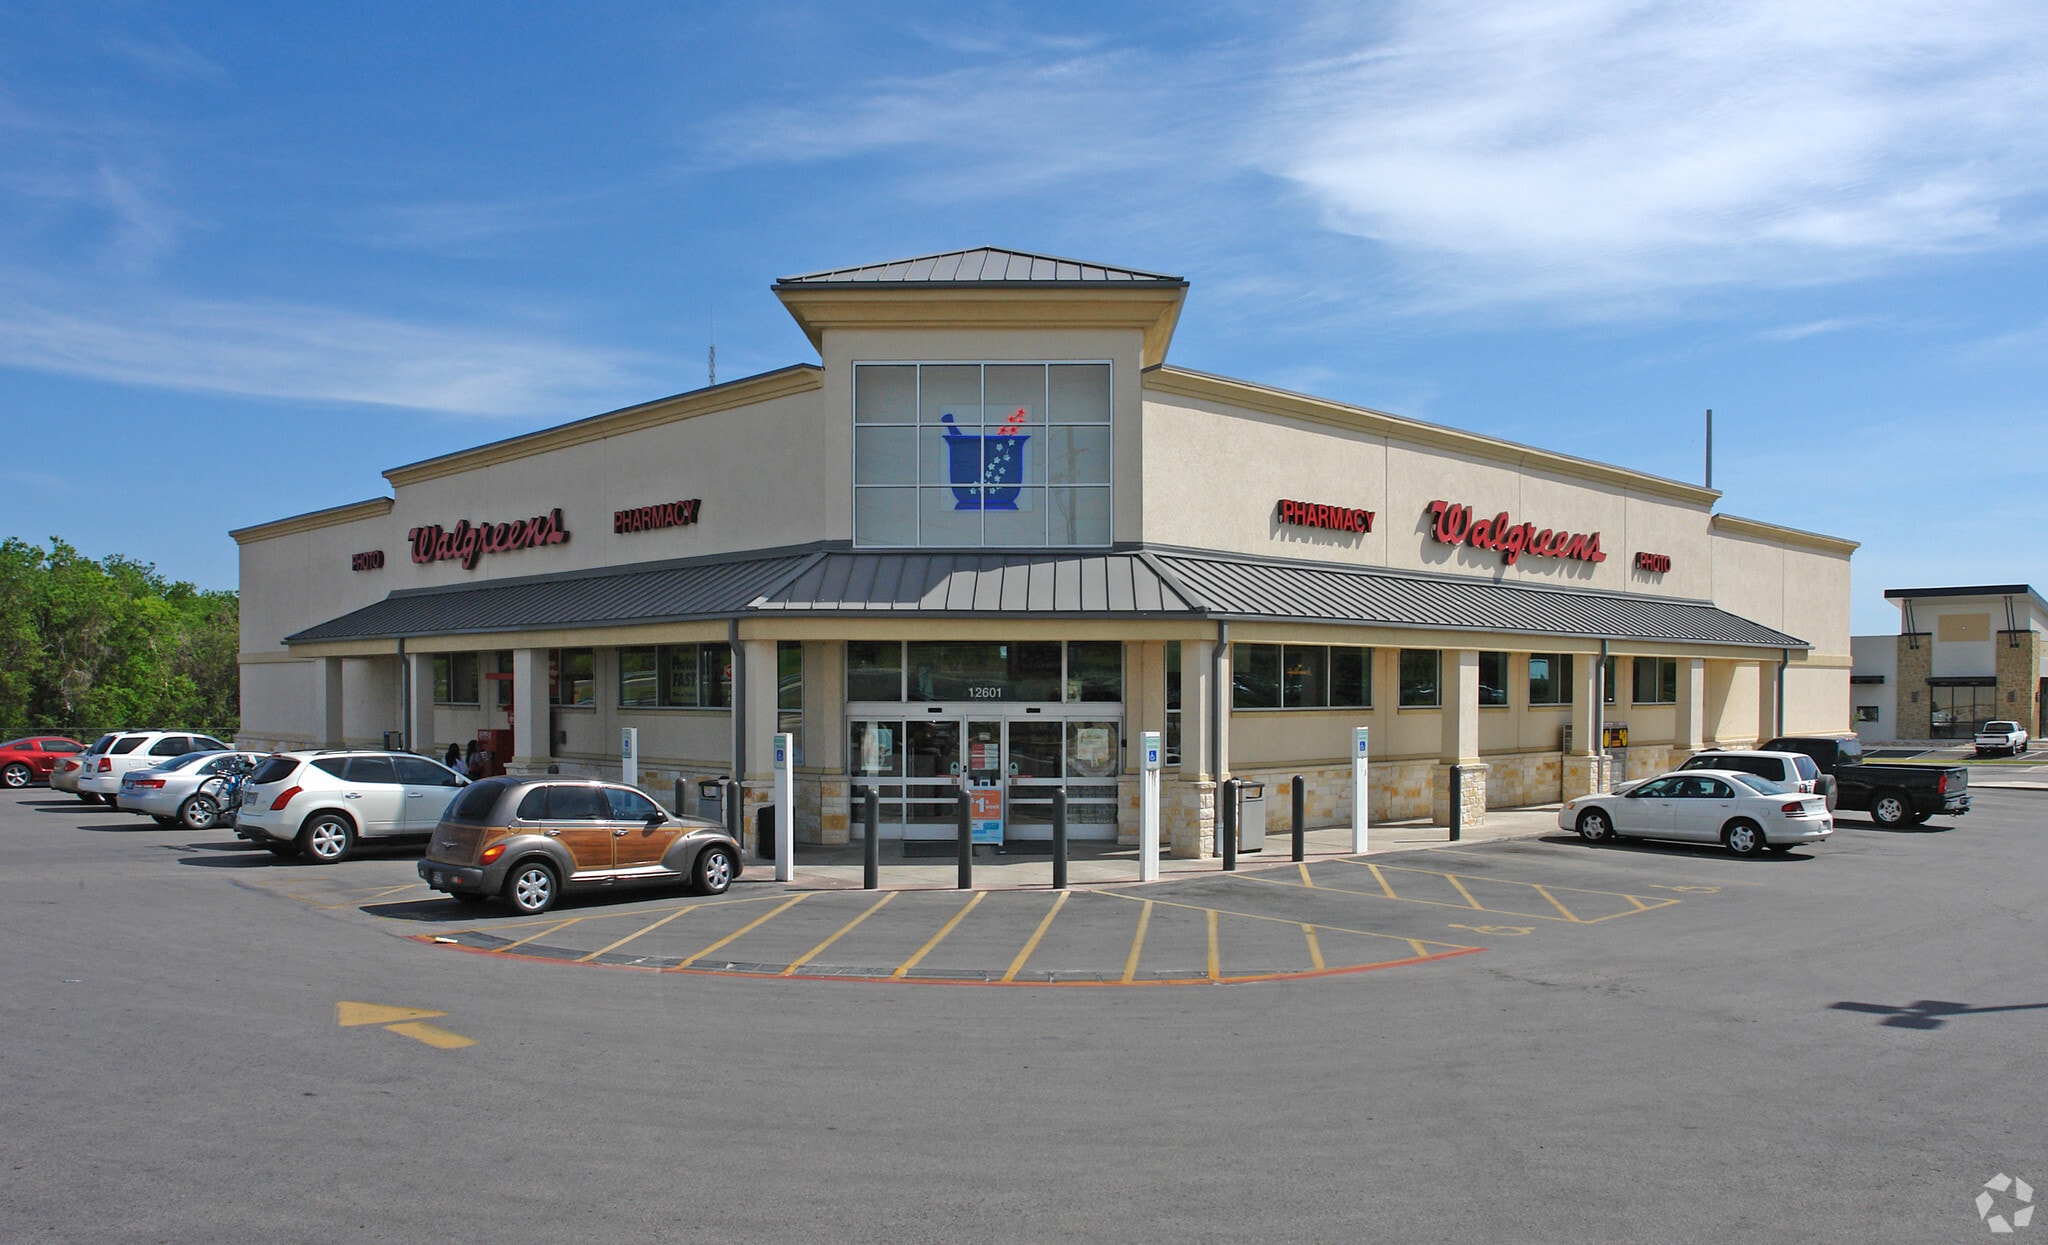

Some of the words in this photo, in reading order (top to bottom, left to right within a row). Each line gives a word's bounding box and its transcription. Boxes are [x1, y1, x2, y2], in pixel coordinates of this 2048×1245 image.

[614, 499, 701, 534] PHARMACY
[1280, 500, 1375, 533] PHARMACY
[1426, 500, 1606, 565] Walgreens
[408, 508, 570, 570] Walgreens
[352, 550, 382, 571] PHOTO
[1638, 552, 1671, 573] PHOTO
[969, 687, 1001, 698] 12601
